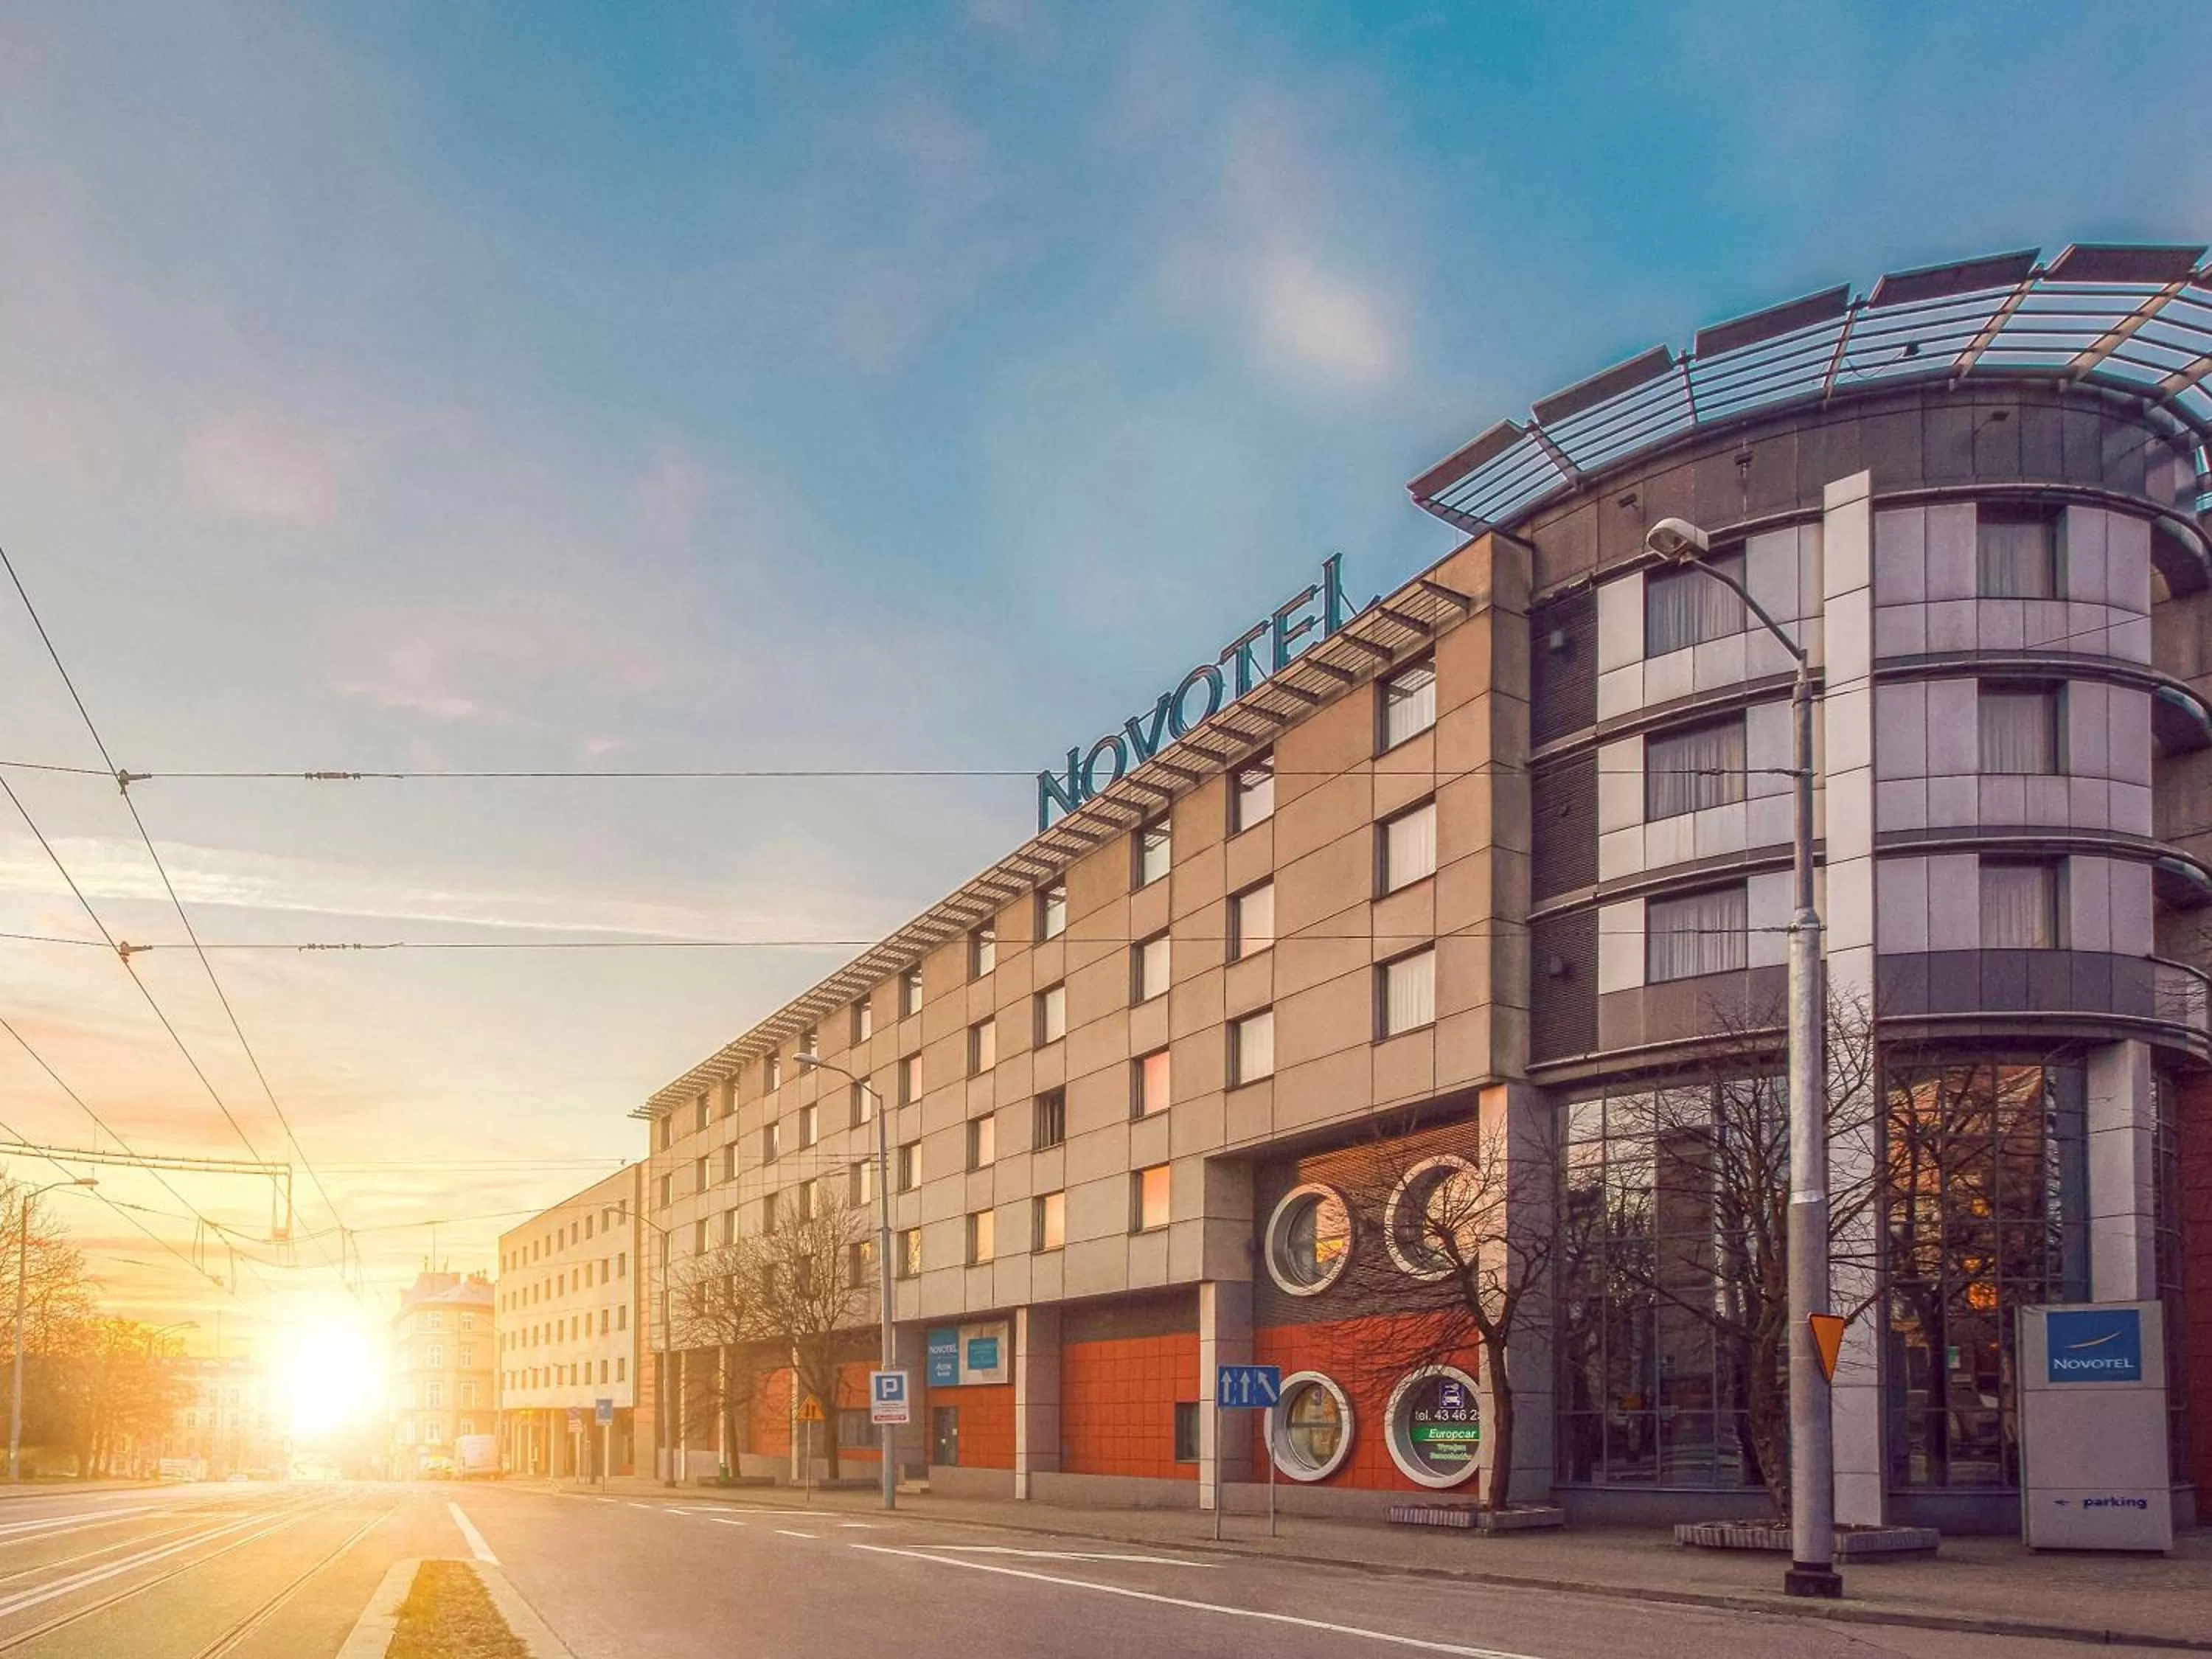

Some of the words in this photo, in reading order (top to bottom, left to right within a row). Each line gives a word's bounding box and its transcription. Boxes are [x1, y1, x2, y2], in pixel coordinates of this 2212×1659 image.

[1037, 552, 1381, 836] NOVOTEL
[2053, 1357, 2135, 1369] NOVOTEL
[882, 1377, 897, 1399] P
[1415, 1409, 1431, 1421] tel.
[1434, 1409, 1449, 1421] 43
[1452, 1409, 1467, 1421] 46
[1470, 1409, 1480, 1421] 2
[1429, 1428, 1476, 1440] Europcar
[2083, 1496, 2147, 1510] parking
